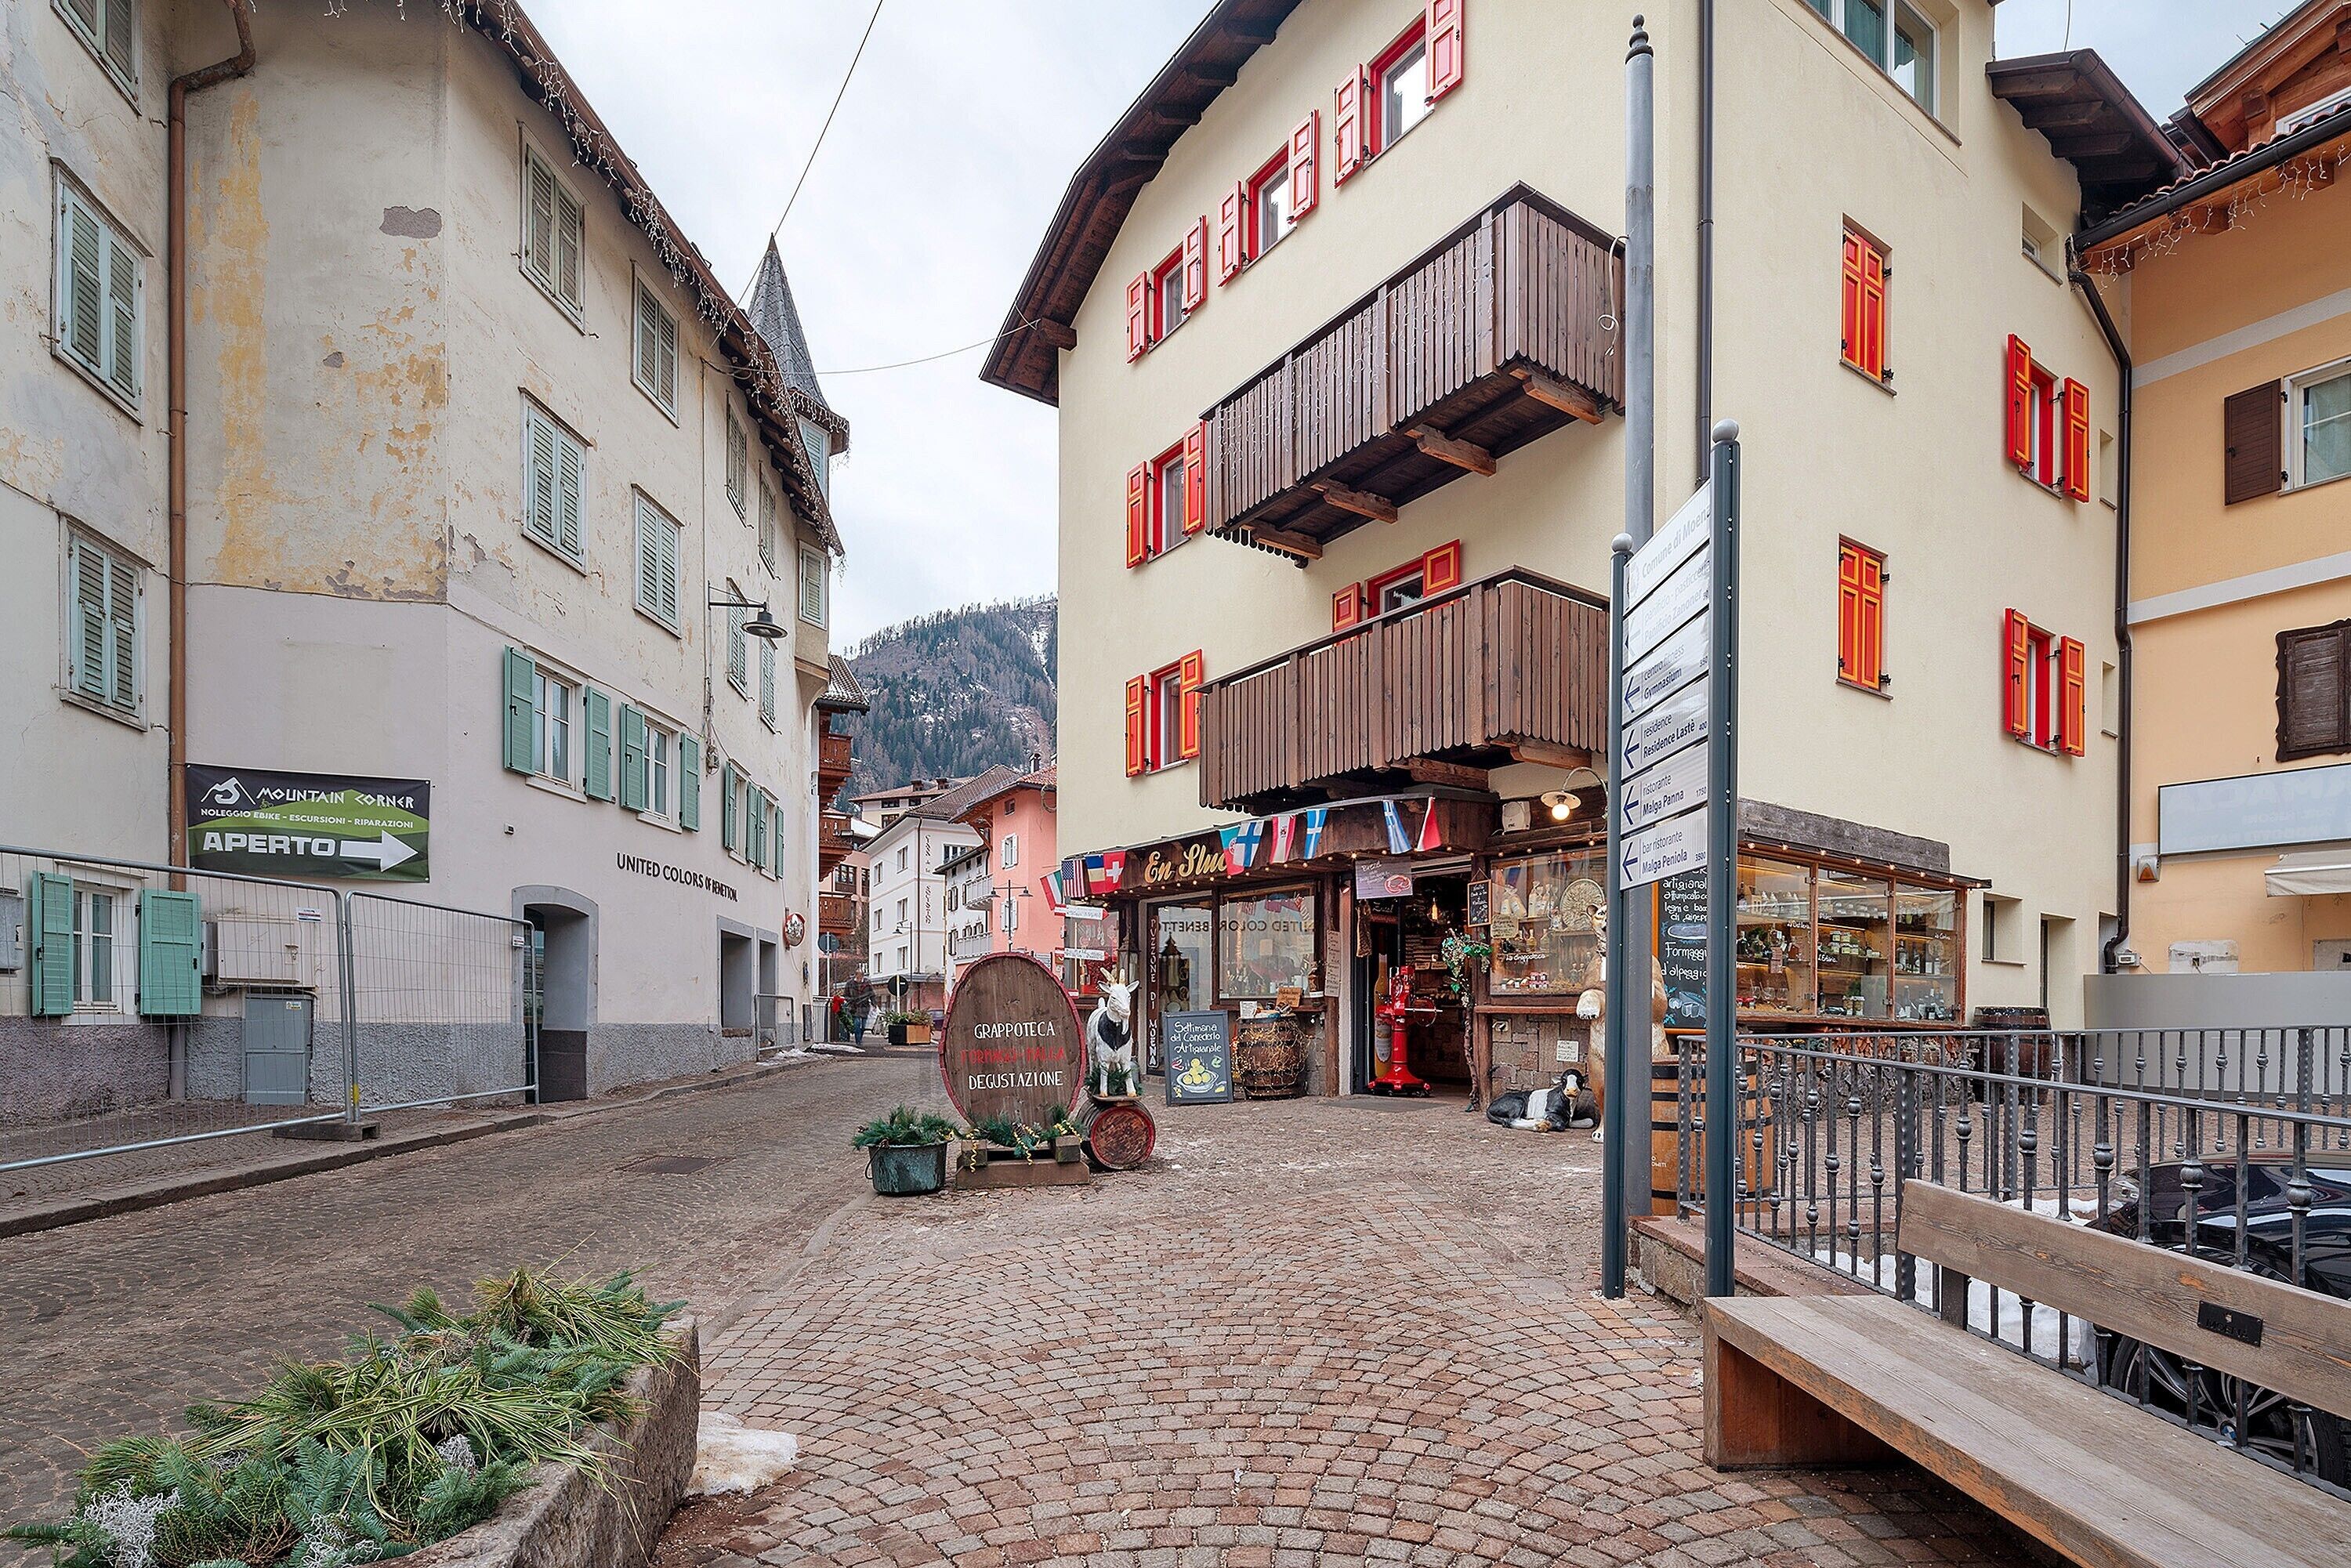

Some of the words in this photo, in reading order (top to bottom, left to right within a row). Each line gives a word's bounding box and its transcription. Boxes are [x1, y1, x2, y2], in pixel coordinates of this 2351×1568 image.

[1643, 541, 1672, 578] Comune
[1673, 529, 1683, 549] di
[1683, 505, 1711, 541] Moena
[1646, 613, 1672, 640] Panificio
[1672, 588, 1702, 620] Zanoner
[1644, 661, 1662, 680] centro
[1644, 668, 1683, 701] Gymnasium
[1644, 715, 1672, 738] residence
[1643, 733, 1675, 759] Residence
[1676, 719, 1695, 741] Lastè
[1643, 775, 1672, 797] ristorante
[256, 787, 345, 805] MOUNTAIN
[354, 794, 415, 809] CORNER
[1643, 800, 1661, 817] Malga
[1663, 790, 1684, 807] Panna
[201, 808, 251, 818] NOLEGGIO
[253, 811, 281, 820] EBIKE
[289, 814, 346, 824] ESCURSIONI
[354, 818, 414, 828] RIPARAZIONI
[202, 831, 336, 856] APERTO
[1643, 842, 1652, 854] bar
[1653, 831, 1683, 851] ristorante
[617, 852, 661, 878] UNITED
[663, 865, 705, 889] COLORS
[705, 876, 712, 891] OF
[1143, 851, 1174, 884] En
[1643, 859, 1661, 875] Malga
[1662, 849, 1687, 867] Peniola
[1665, 902, 1682, 914] legni
[1670, 913, 1679, 922] di
[1665, 942, 1707, 961] Formaggi
[1150, 991, 1157, 1010] DI
[974, 1021, 1056, 1039] GRAPPOTECA
[1170, 1033, 1182, 1042] del
[1183, 1031, 1222, 1042] Canederlo
[1174, 1020, 1218, 1034] Settimana
[1148, 1019, 1157, 1066] MOENA
[1174, 1042, 1223, 1055] Artigianale
[968, 1070, 1064, 1090] DEGUSTAZIONE
